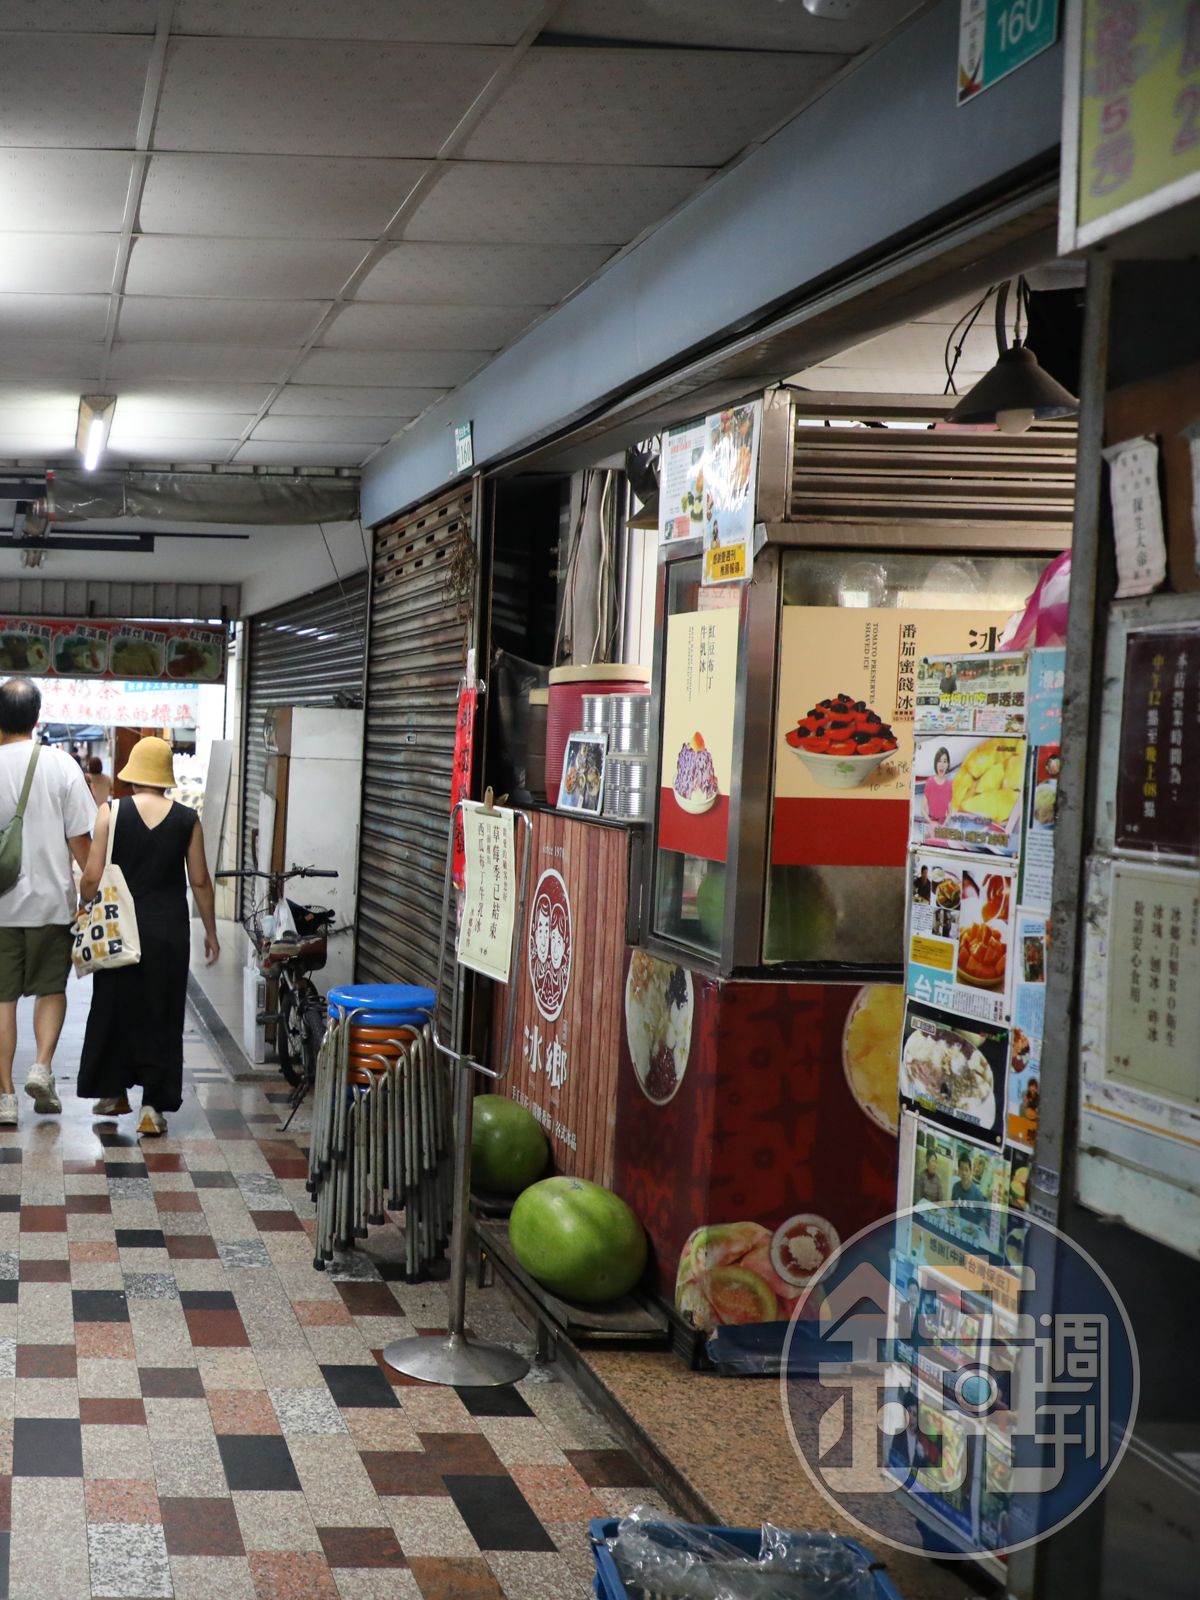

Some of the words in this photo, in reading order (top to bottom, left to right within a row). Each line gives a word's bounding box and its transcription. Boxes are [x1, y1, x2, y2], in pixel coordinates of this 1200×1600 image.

[489, 825, 500, 939] 草莓季已結束
